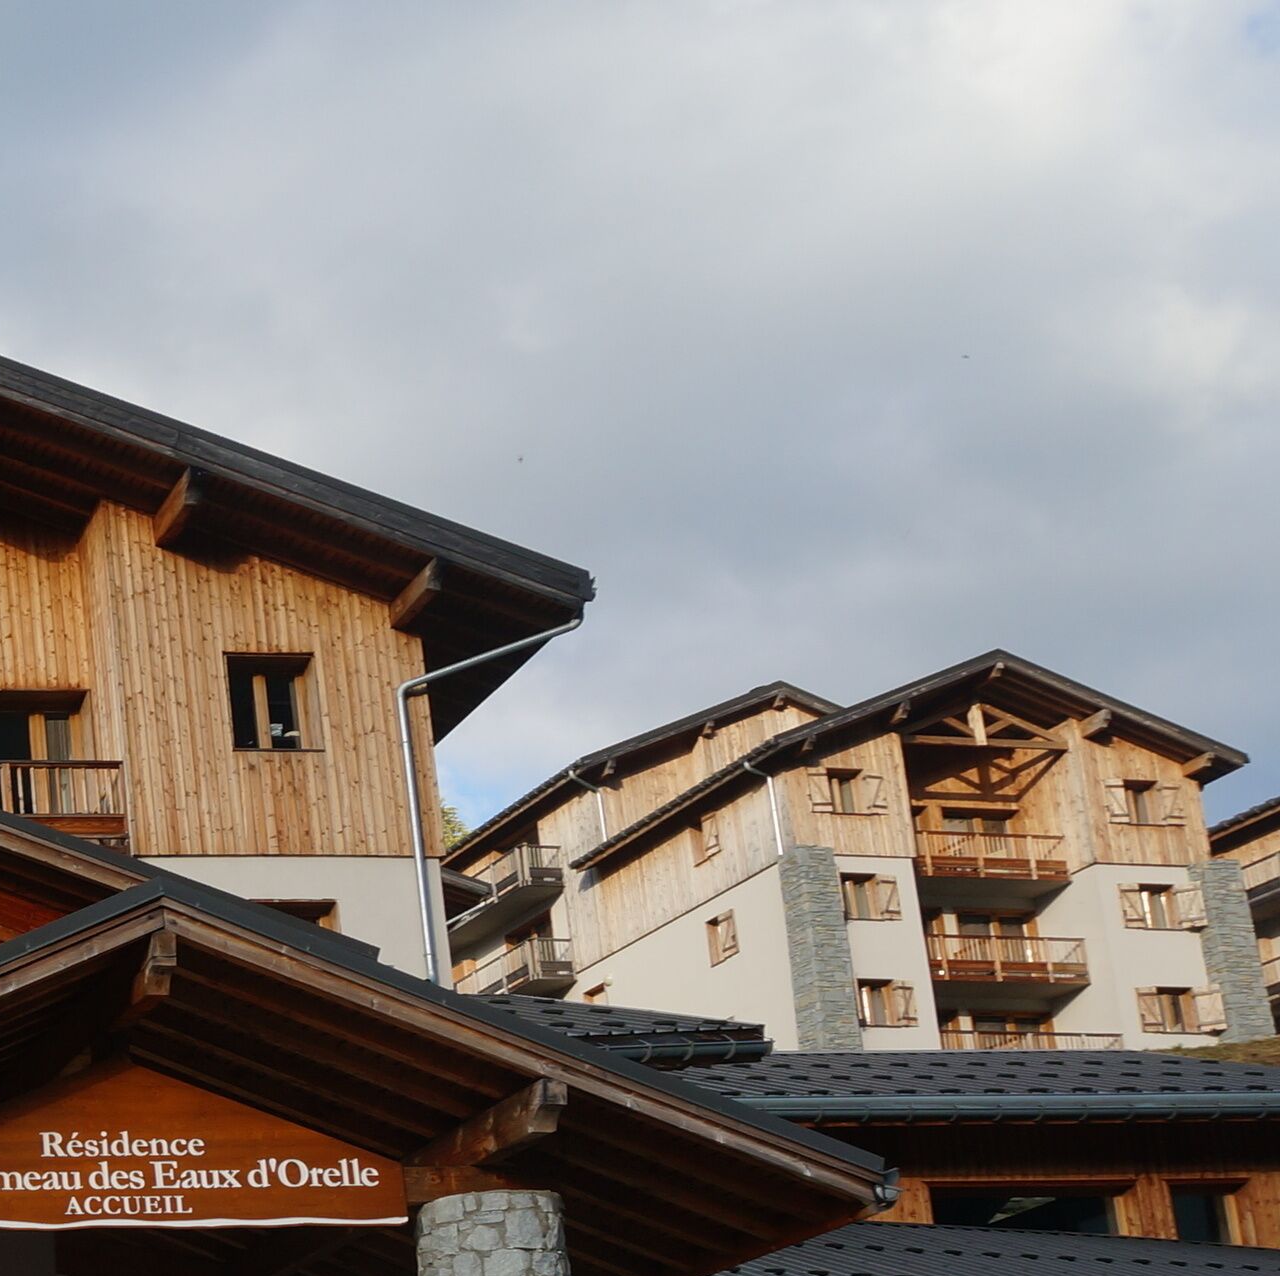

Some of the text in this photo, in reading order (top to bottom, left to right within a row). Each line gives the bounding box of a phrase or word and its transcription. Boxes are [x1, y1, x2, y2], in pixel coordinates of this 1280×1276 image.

[39, 1130, 205, 1158] Résidence
[88, 1160, 146, 1190] des
[149, 1160, 242, 1189] Eaux
[247, 1157, 380, 1188] d'Orelle
[64, 1195, 194, 1216] ACCUEIL
